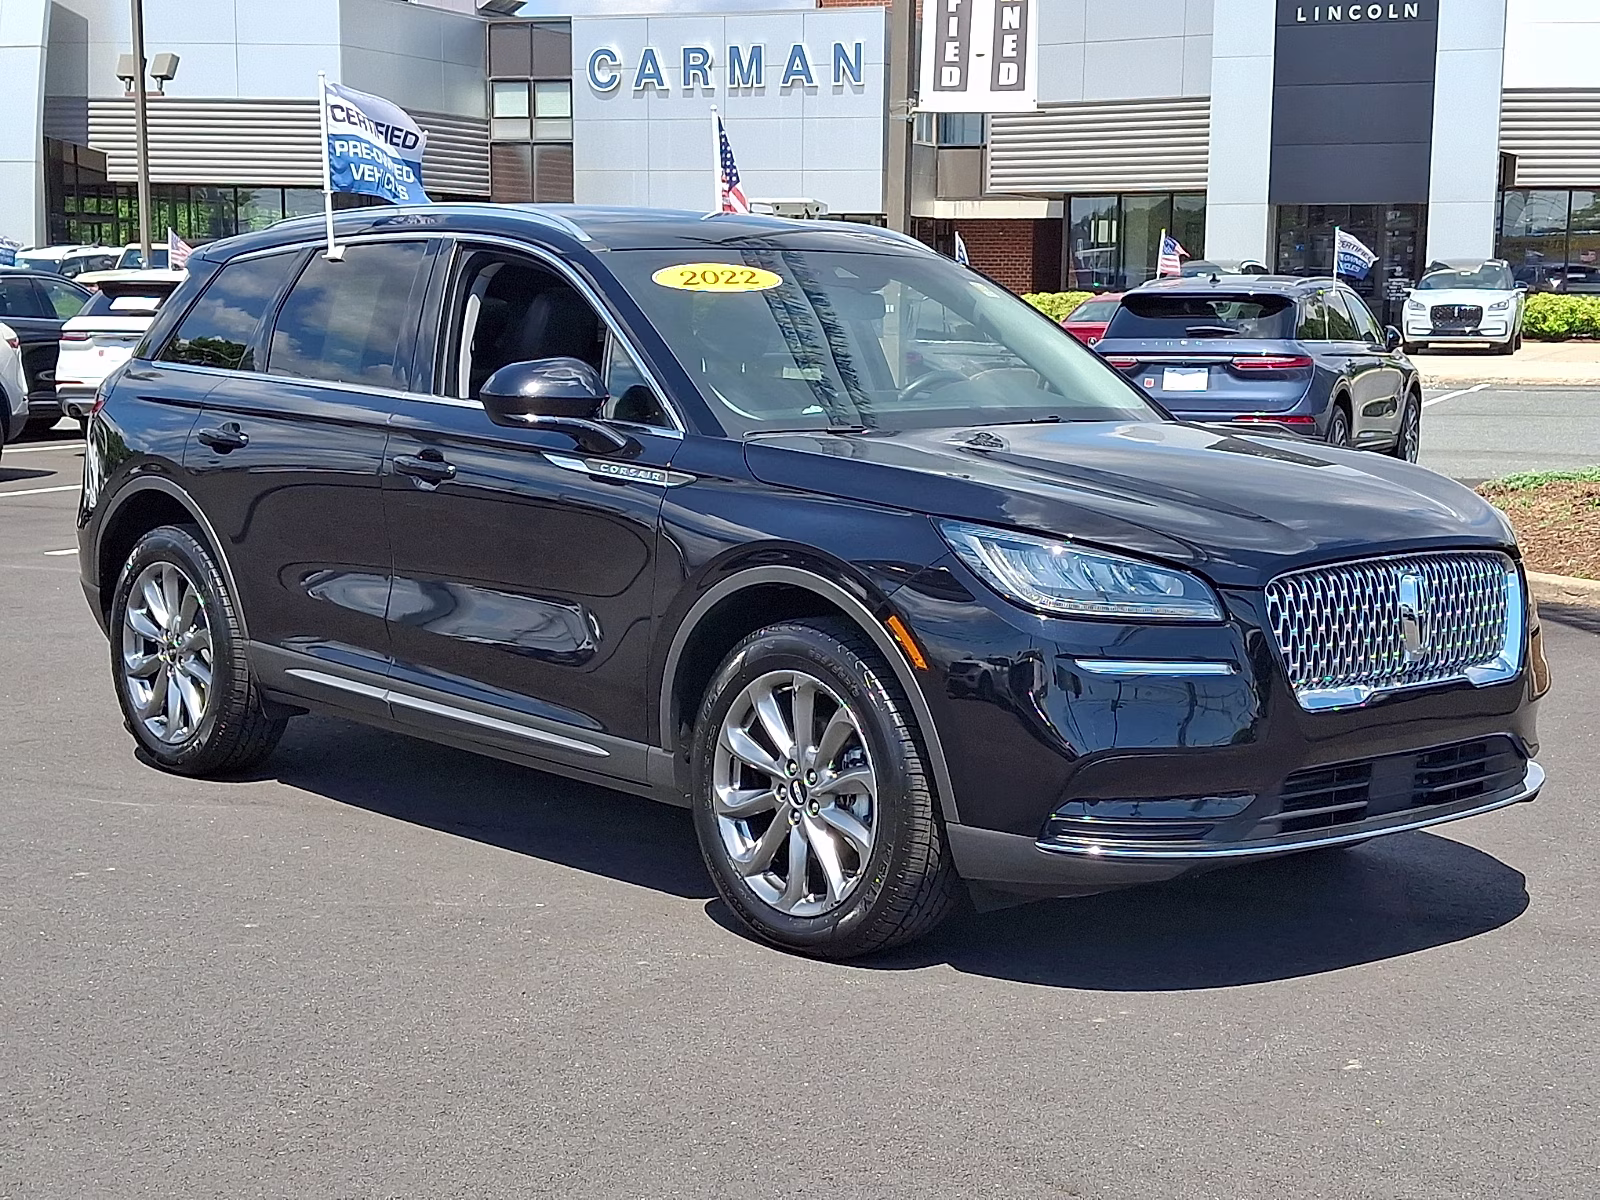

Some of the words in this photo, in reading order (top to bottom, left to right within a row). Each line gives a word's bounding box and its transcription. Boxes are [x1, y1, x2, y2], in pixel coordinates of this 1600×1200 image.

[1297, 2, 1418, 22] LINCOLN
[998, 0, 1021, 86] NED
[586, 40, 865, 92] CARMAN
[330, 104, 419, 150] CERTIFIED
[680, 270, 759, 285] 2022
[600, 463, 661, 481] CORSAIR
